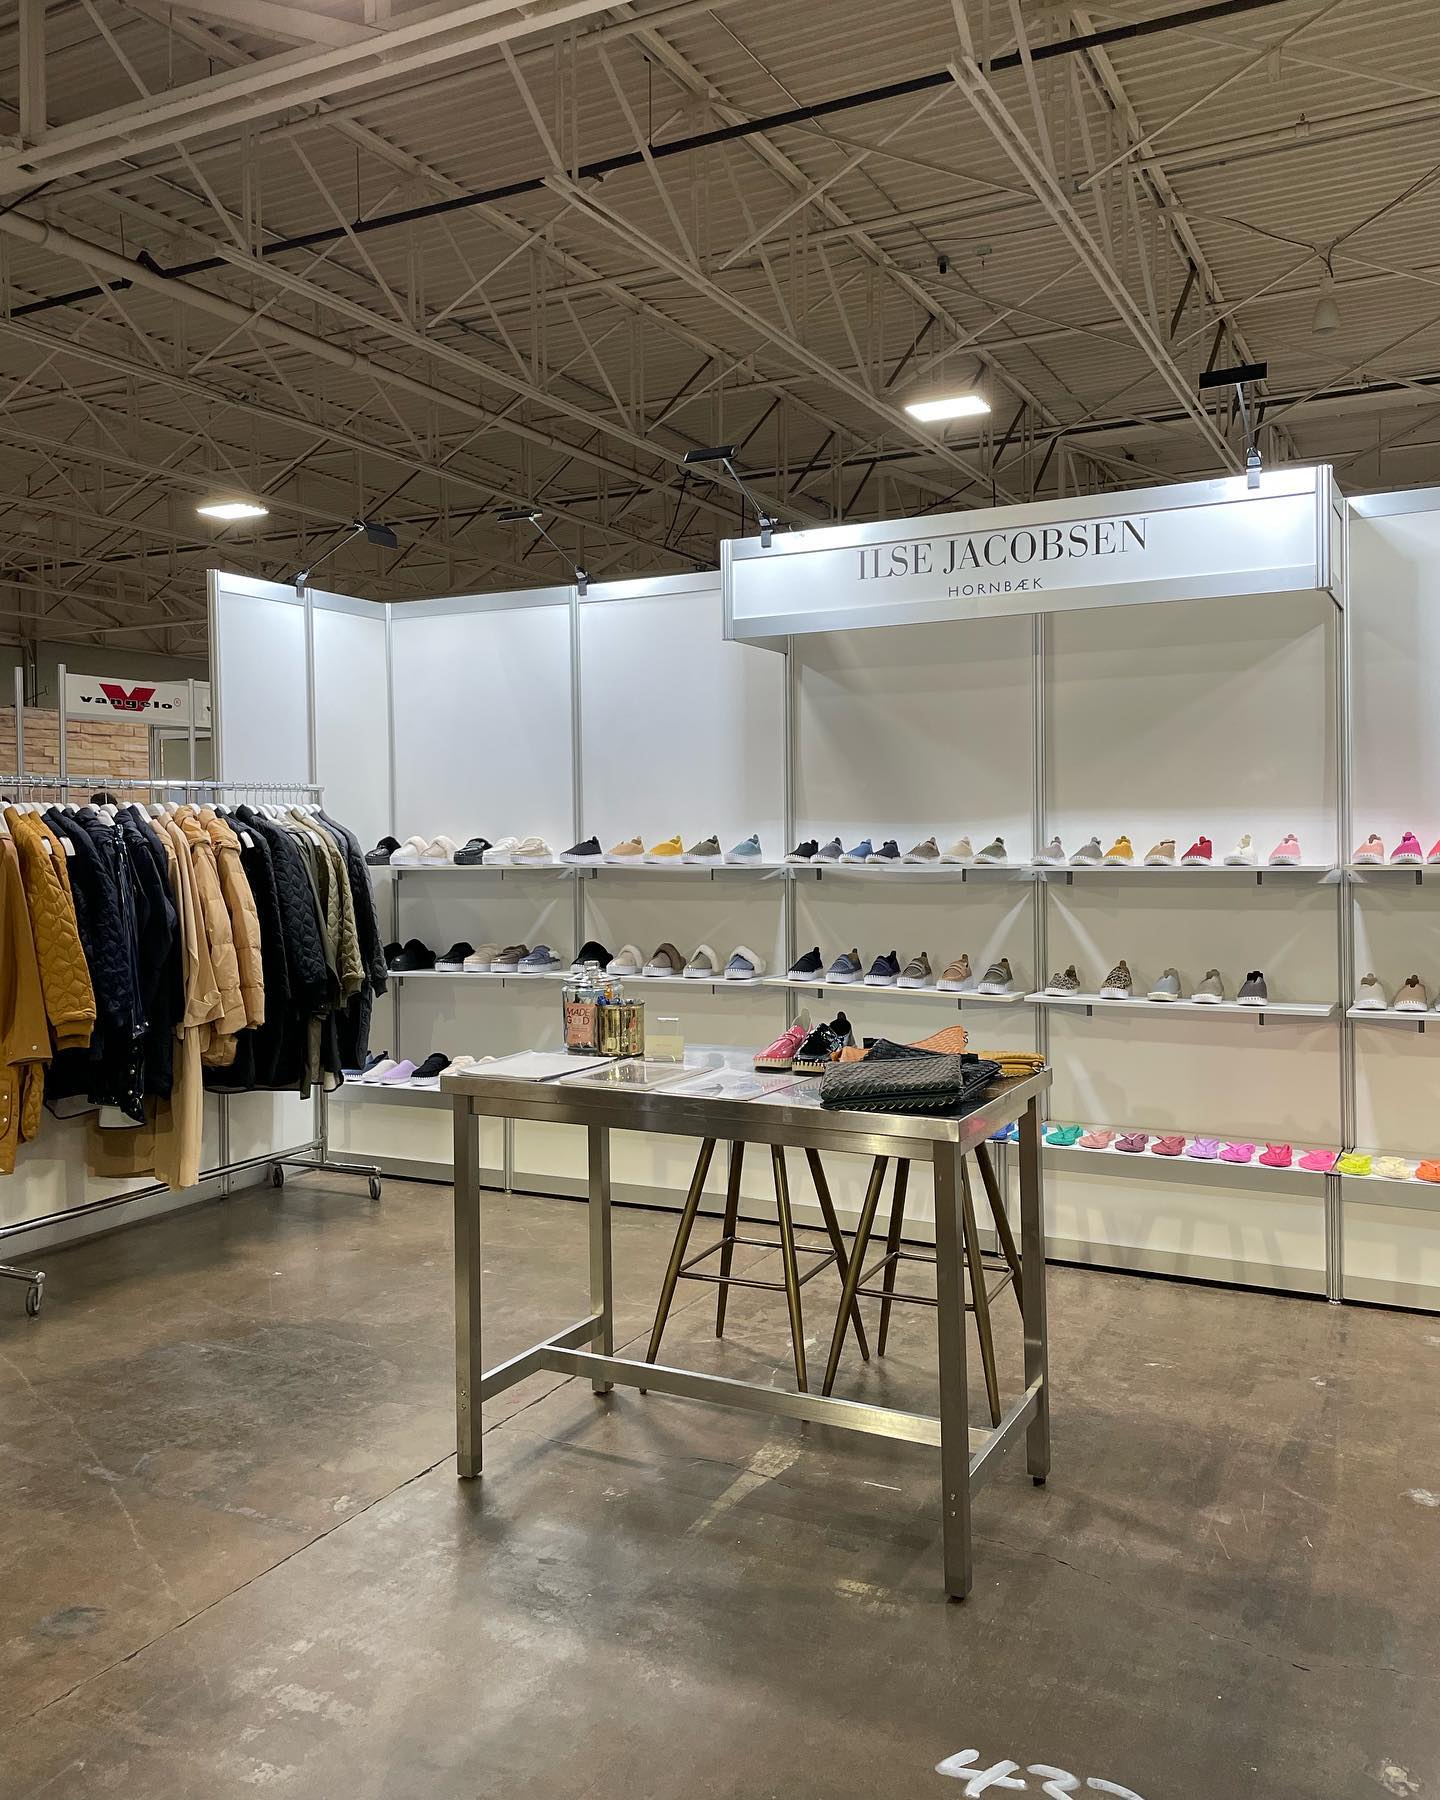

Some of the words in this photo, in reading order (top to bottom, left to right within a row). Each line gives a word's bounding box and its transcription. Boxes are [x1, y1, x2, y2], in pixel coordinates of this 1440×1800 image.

[856, 543, 933, 580] ILSE
[942, 517, 1150, 574] JACOBSEN
[948, 577, 1043, 598] HORNBÆK
[566, 1007, 591, 1017] MADE
